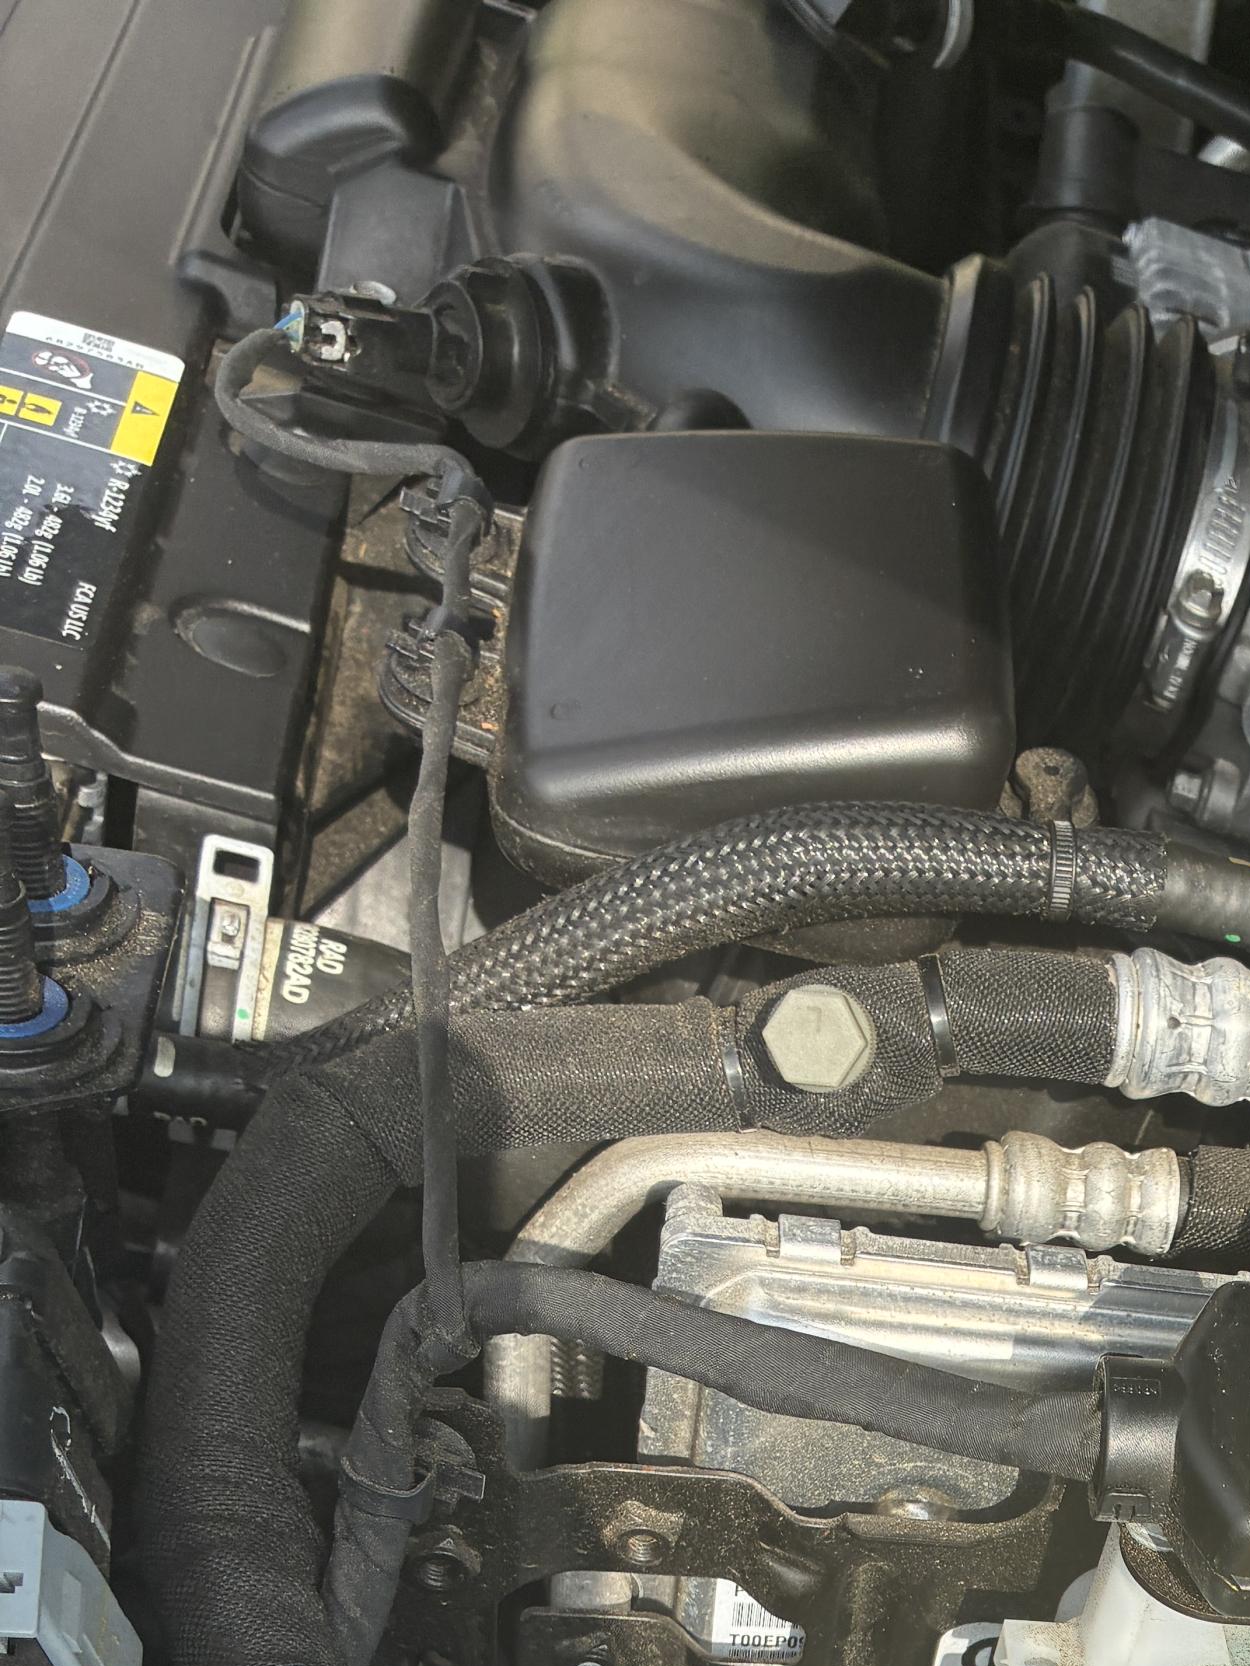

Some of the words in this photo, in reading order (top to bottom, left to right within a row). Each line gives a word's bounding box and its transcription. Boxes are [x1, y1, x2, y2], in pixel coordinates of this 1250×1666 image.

[22, 474, 46, 496] 2.0L
[52, 483, 75, 505] 3.6L
[94, 478, 130, 534] R-1234yf
[4, 506, 33, 531] 482g
[34, 514, 63, 540] 482g
[28, 540, 55, 569] (1.06
[72, 581, 97, 604] FCA
[69, 604, 90, 619] US
[61, 618, 85, 641] LLC
[316, 938, 348, 975] RAD
